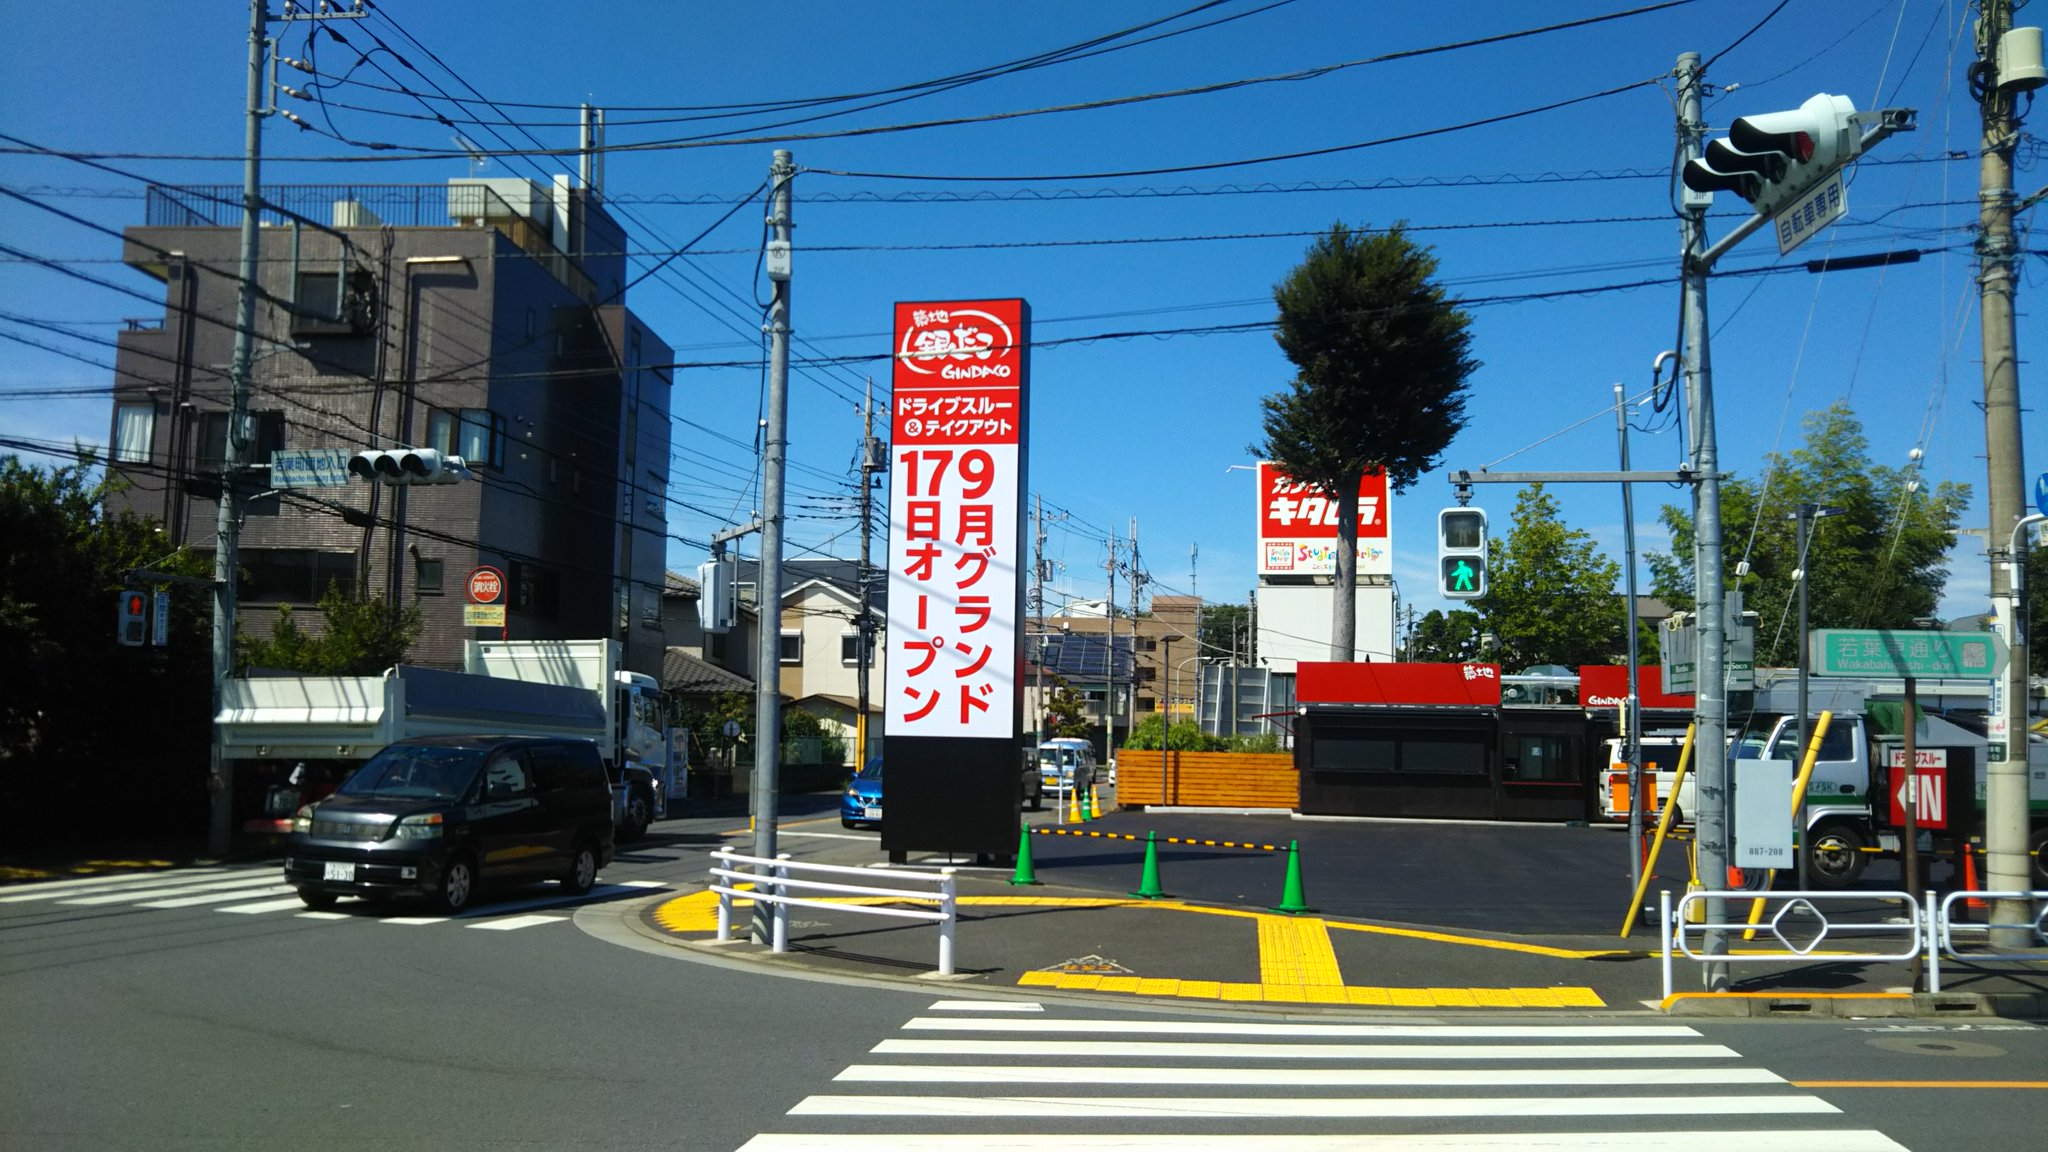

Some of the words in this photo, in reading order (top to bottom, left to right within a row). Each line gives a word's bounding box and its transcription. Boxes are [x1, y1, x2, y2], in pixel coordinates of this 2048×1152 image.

[1781, 182, 1840, 245] 自転車専用
[913, 309, 949, 328] 築地
[941, 364, 1011, 379] GINDACO
[898, 396, 1013, 416] ドライブスルー
[473, 581, 499, 593] 消火栓
[1838, 638, 1951, 658] 若葉東通り
